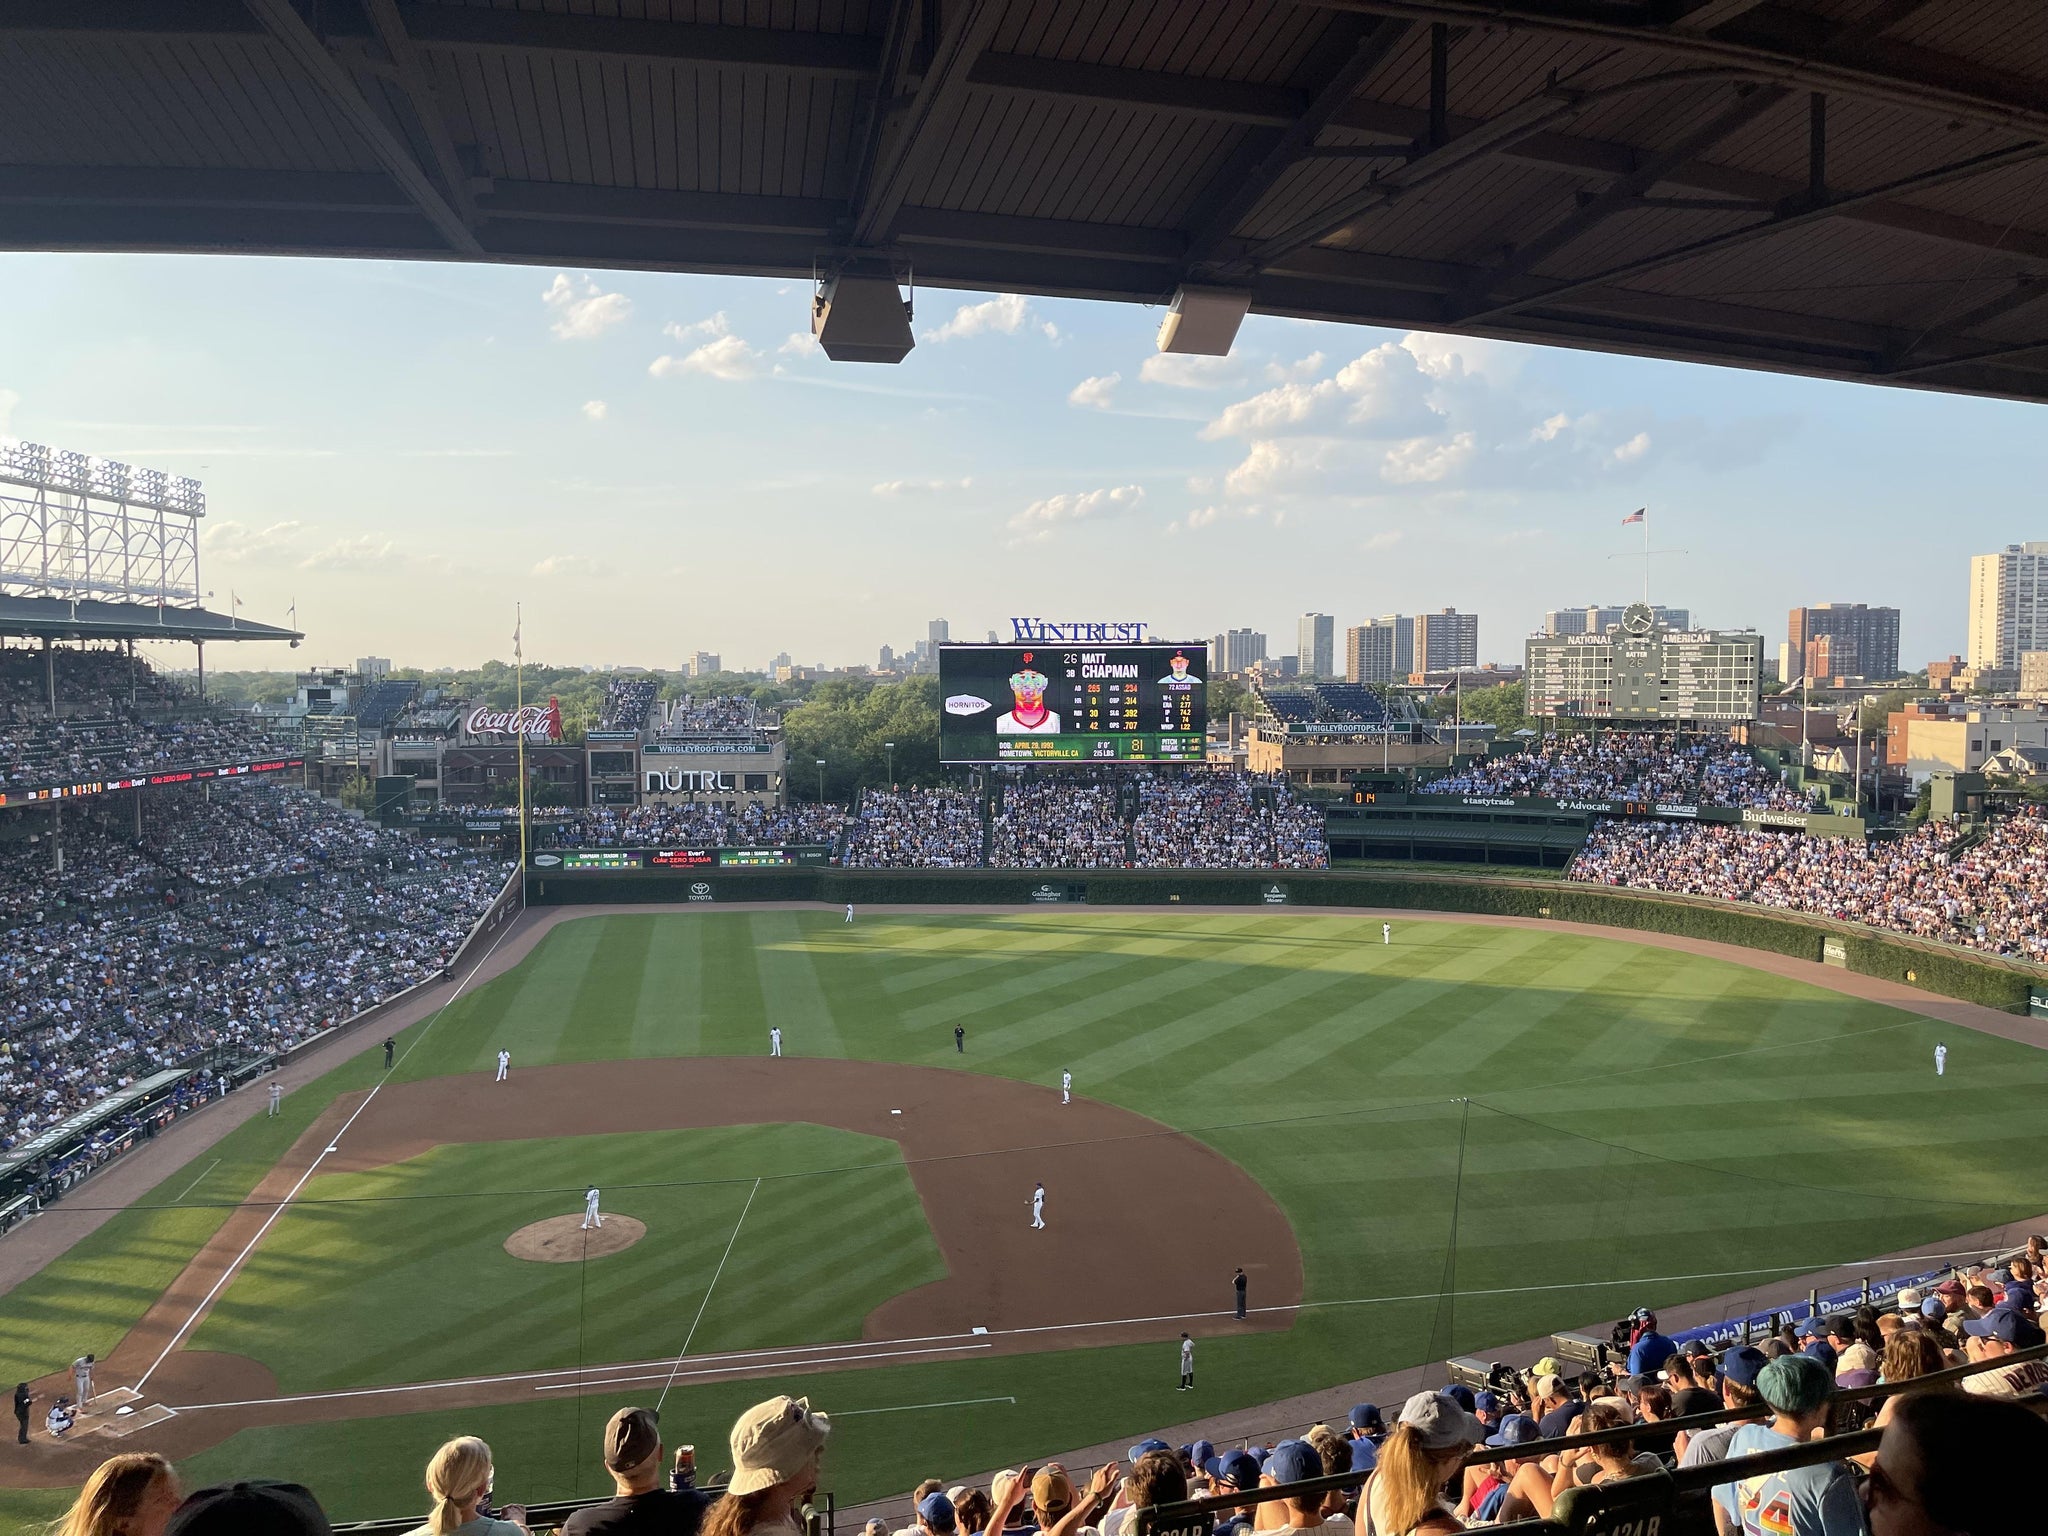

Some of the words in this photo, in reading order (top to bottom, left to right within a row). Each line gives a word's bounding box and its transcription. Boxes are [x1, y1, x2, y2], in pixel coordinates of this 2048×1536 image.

[1010, 618, 1148, 641] WINTRUST
[1567, 635, 1613, 645] NATIONAL
[1661, 633, 1711, 643] AMERICAN
[1063, 653, 1078, 664] 26
[1081, 653, 1107, 664] MATT
[1629, 658, 1643, 668] 26
[1065, 669, 1076, 678] 3B
[1081, 664, 1139, 678] CHAPMAN
[1646, 676, 1653, 686] 2
[1123, 697, 1137, 705] .314
[1089, 709, 1099, 717] 30
[1123, 709, 1138, 717] .392
[466, 706, 557, 735] Coca-Cola
[1089, 721, 1099, 730] 42
[1123, 721, 1138, 730] .707
[659, 745, 756, 753] WRIGLEYROOFTOPS.COM
[1014, 741, 1031, 749] APRIL
[1040, 741, 1054, 749] 1993
[1131, 739, 1143, 751] 81
[999, 749, 1033, 757] HOMETOWN:
[1034, 749, 1070, 757] VICTORVILLE,
[1070, 749, 1079, 757] CA
[1093, 749, 1104, 757] 215
[1104, 749, 1115, 757] LBS
[163, 774, 176, 783] ZERO
[176, 773, 192, 781] SUGAR
[107, 781, 120, 790] Best
[131, 778, 146, 787] Ever?
[1355, 792, 1362, 803] 0
[1366, 793, 1375, 803] 14
[1468, 798, 1515, 806] tastytrade
[1568, 800, 1612, 811] Advocate
[1637, 803, 1647, 814] 14
[1655, 804, 1698, 813] GRAINGER
[1742, 809, 1808, 826] Budweiser
[652, 856, 668, 864] Coke
[1031, 890, 1062, 898] Gallagher
[1824, 944, 1846, 958] Hefty
[22, 1127, 71, 1149] CUBS
